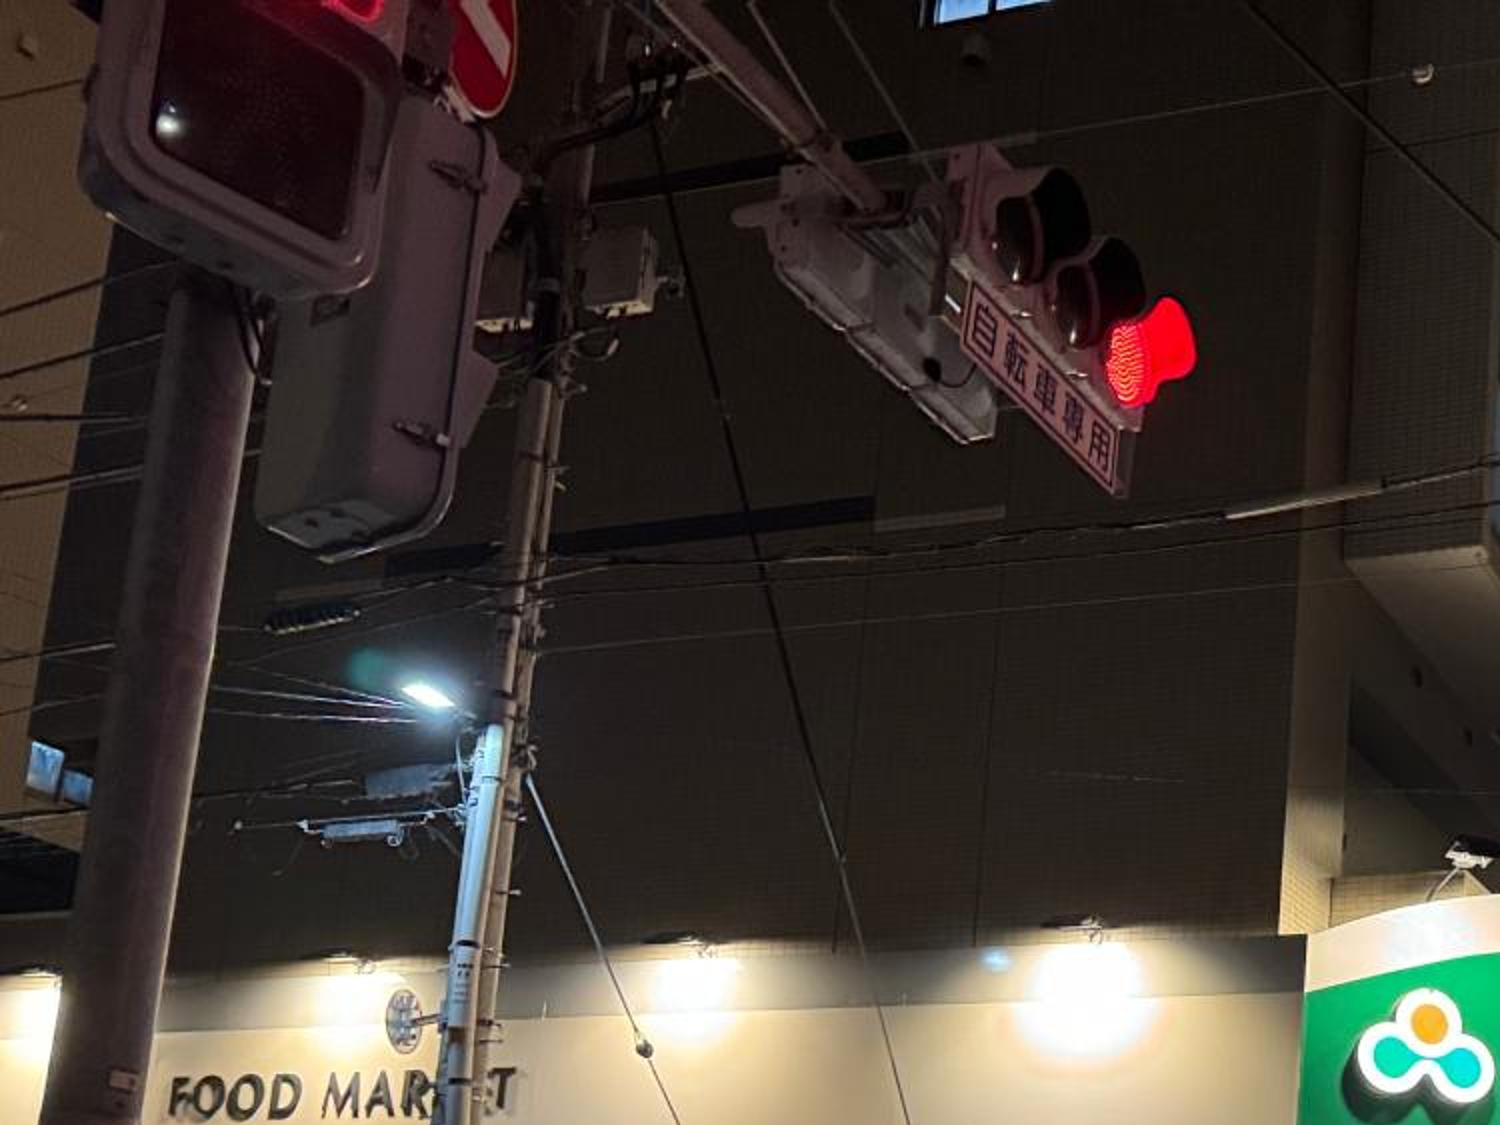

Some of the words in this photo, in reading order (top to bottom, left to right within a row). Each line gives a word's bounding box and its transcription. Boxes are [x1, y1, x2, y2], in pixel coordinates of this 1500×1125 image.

[972, 301, 1111, 475] 自転車専用
[168, 1072, 302, 1121] FOOD
[320, 1066, 517, 1120] MART
